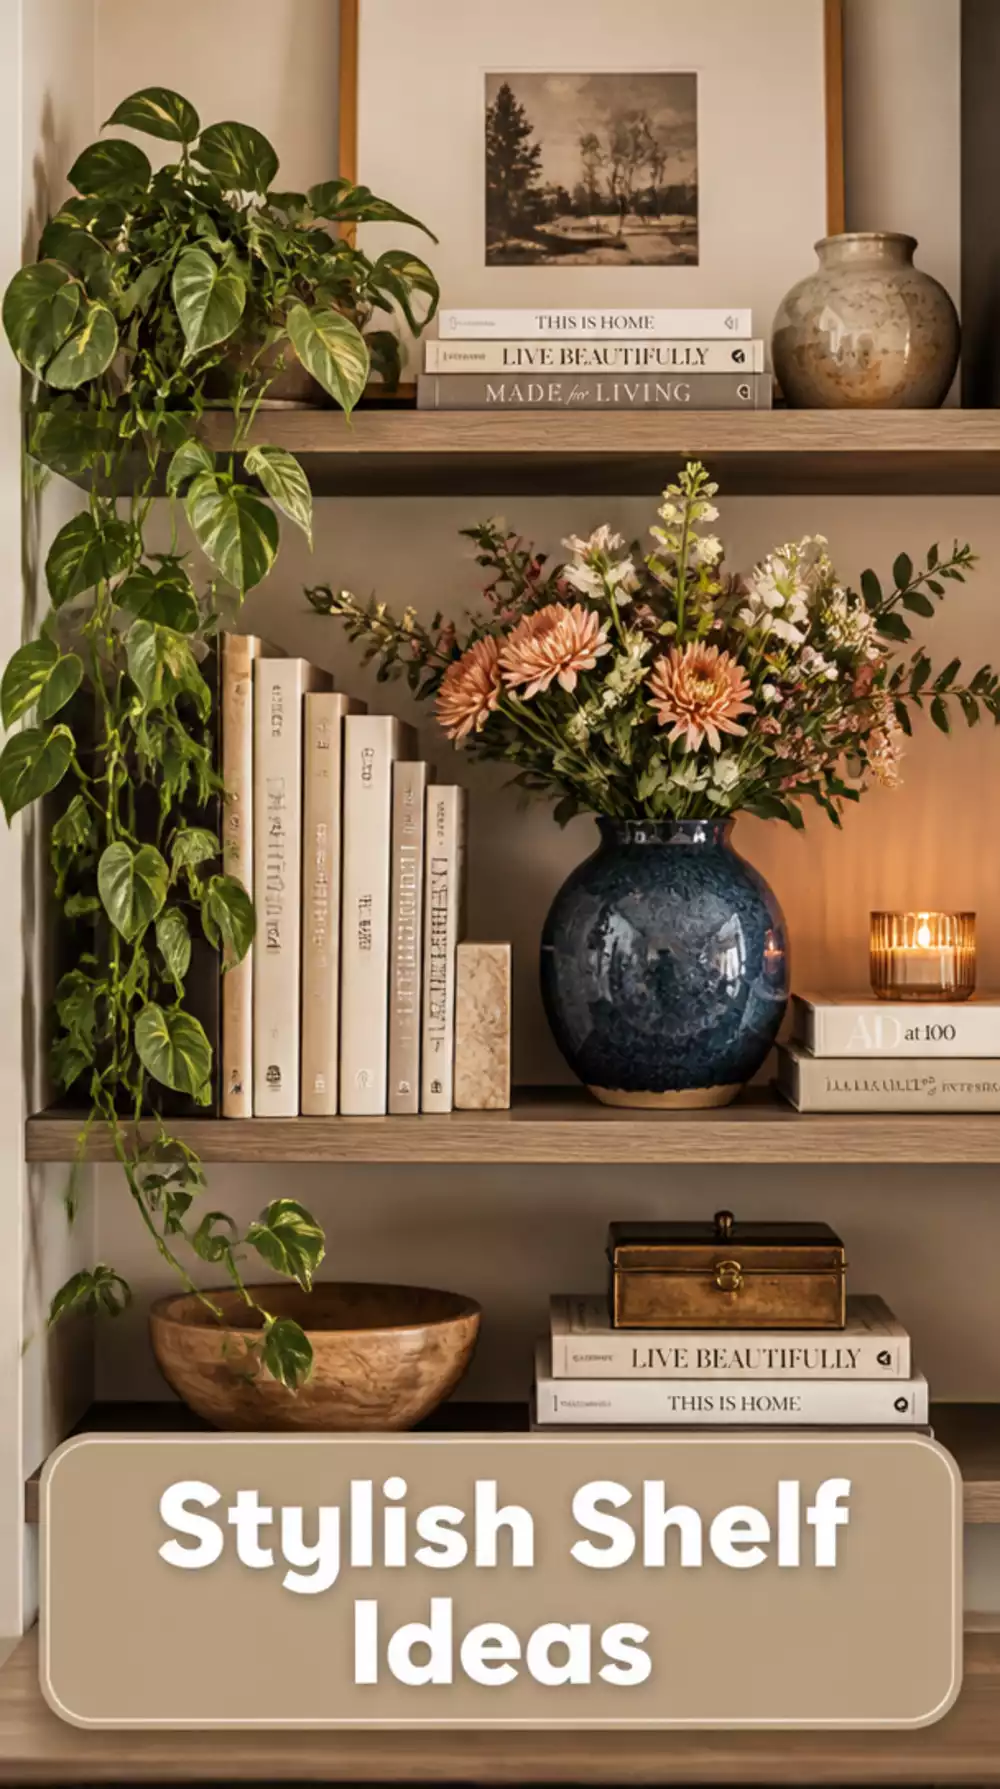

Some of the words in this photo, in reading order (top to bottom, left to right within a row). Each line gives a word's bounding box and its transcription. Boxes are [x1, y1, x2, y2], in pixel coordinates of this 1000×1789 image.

[535, 315, 577, 330] THIS
[581, 315, 597, 330] IS
[600, 315, 655, 330] HOME
[502, 347, 553, 366] LIVE
[560, 347, 710, 366] BEAUTIFULLY
[485, 382, 562, 402] MADE
[565, 383, 590, 406] for
[597, 382, 691, 402] LIVING
[846, 1014, 901, 1049] AD
[904, 1026, 920, 1041] at
[631, 1347, 689, 1369] LIVE
[696, 1347, 861, 1369] BEAUTIFULLY
[667, 1395, 714, 1411] THIS
[719, 1395, 736, 1411] IS
[741, 1395, 801, 1411] HOME
